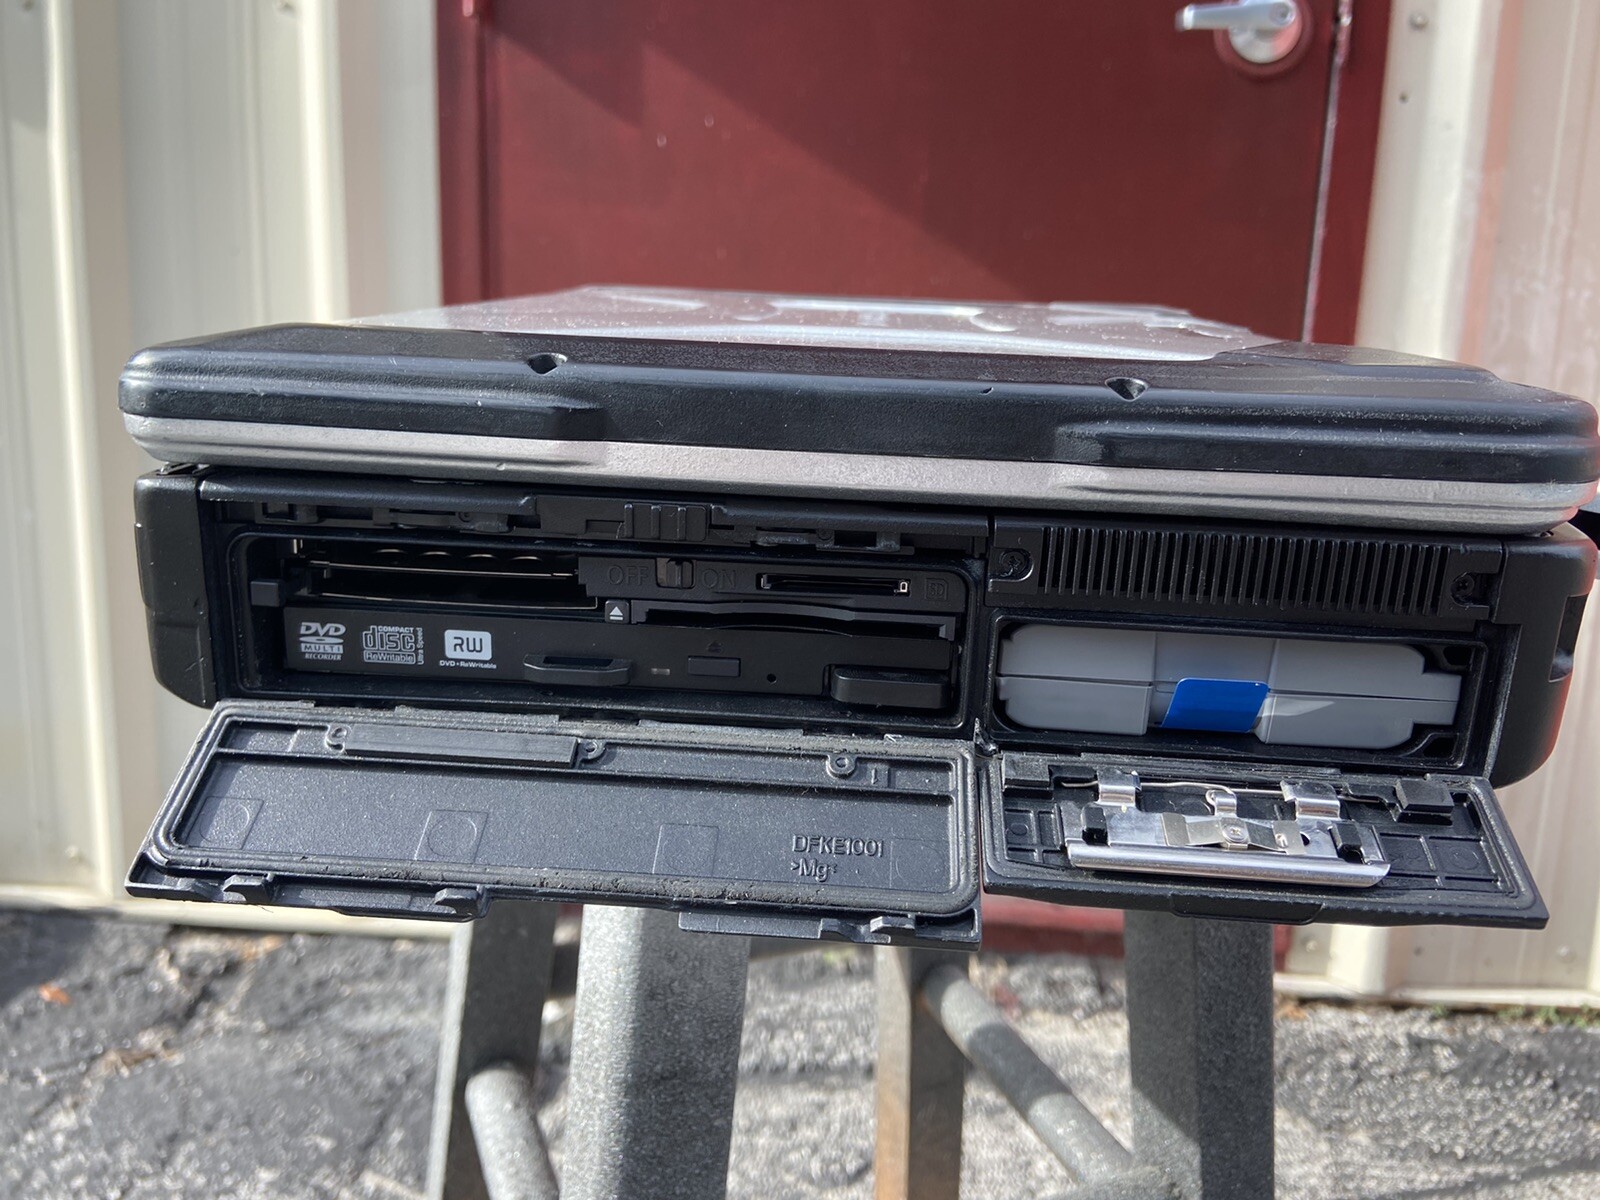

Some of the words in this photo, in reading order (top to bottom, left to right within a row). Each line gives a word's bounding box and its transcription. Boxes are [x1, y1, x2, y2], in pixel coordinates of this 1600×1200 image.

[608, 565, 649, 586] OFF
[702, 568, 736, 590] ON
[300, 622, 346, 636] DVD
[377, 625, 414, 633] COMPACT
[304, 643, 341, 653] MULTI
[453, 636, 483, 653] RW
[304, 653, 342, 661] RECORDER
[366, 651, 414, 663] ReWritable
[792, 834, 884, 857] DFKE1001
